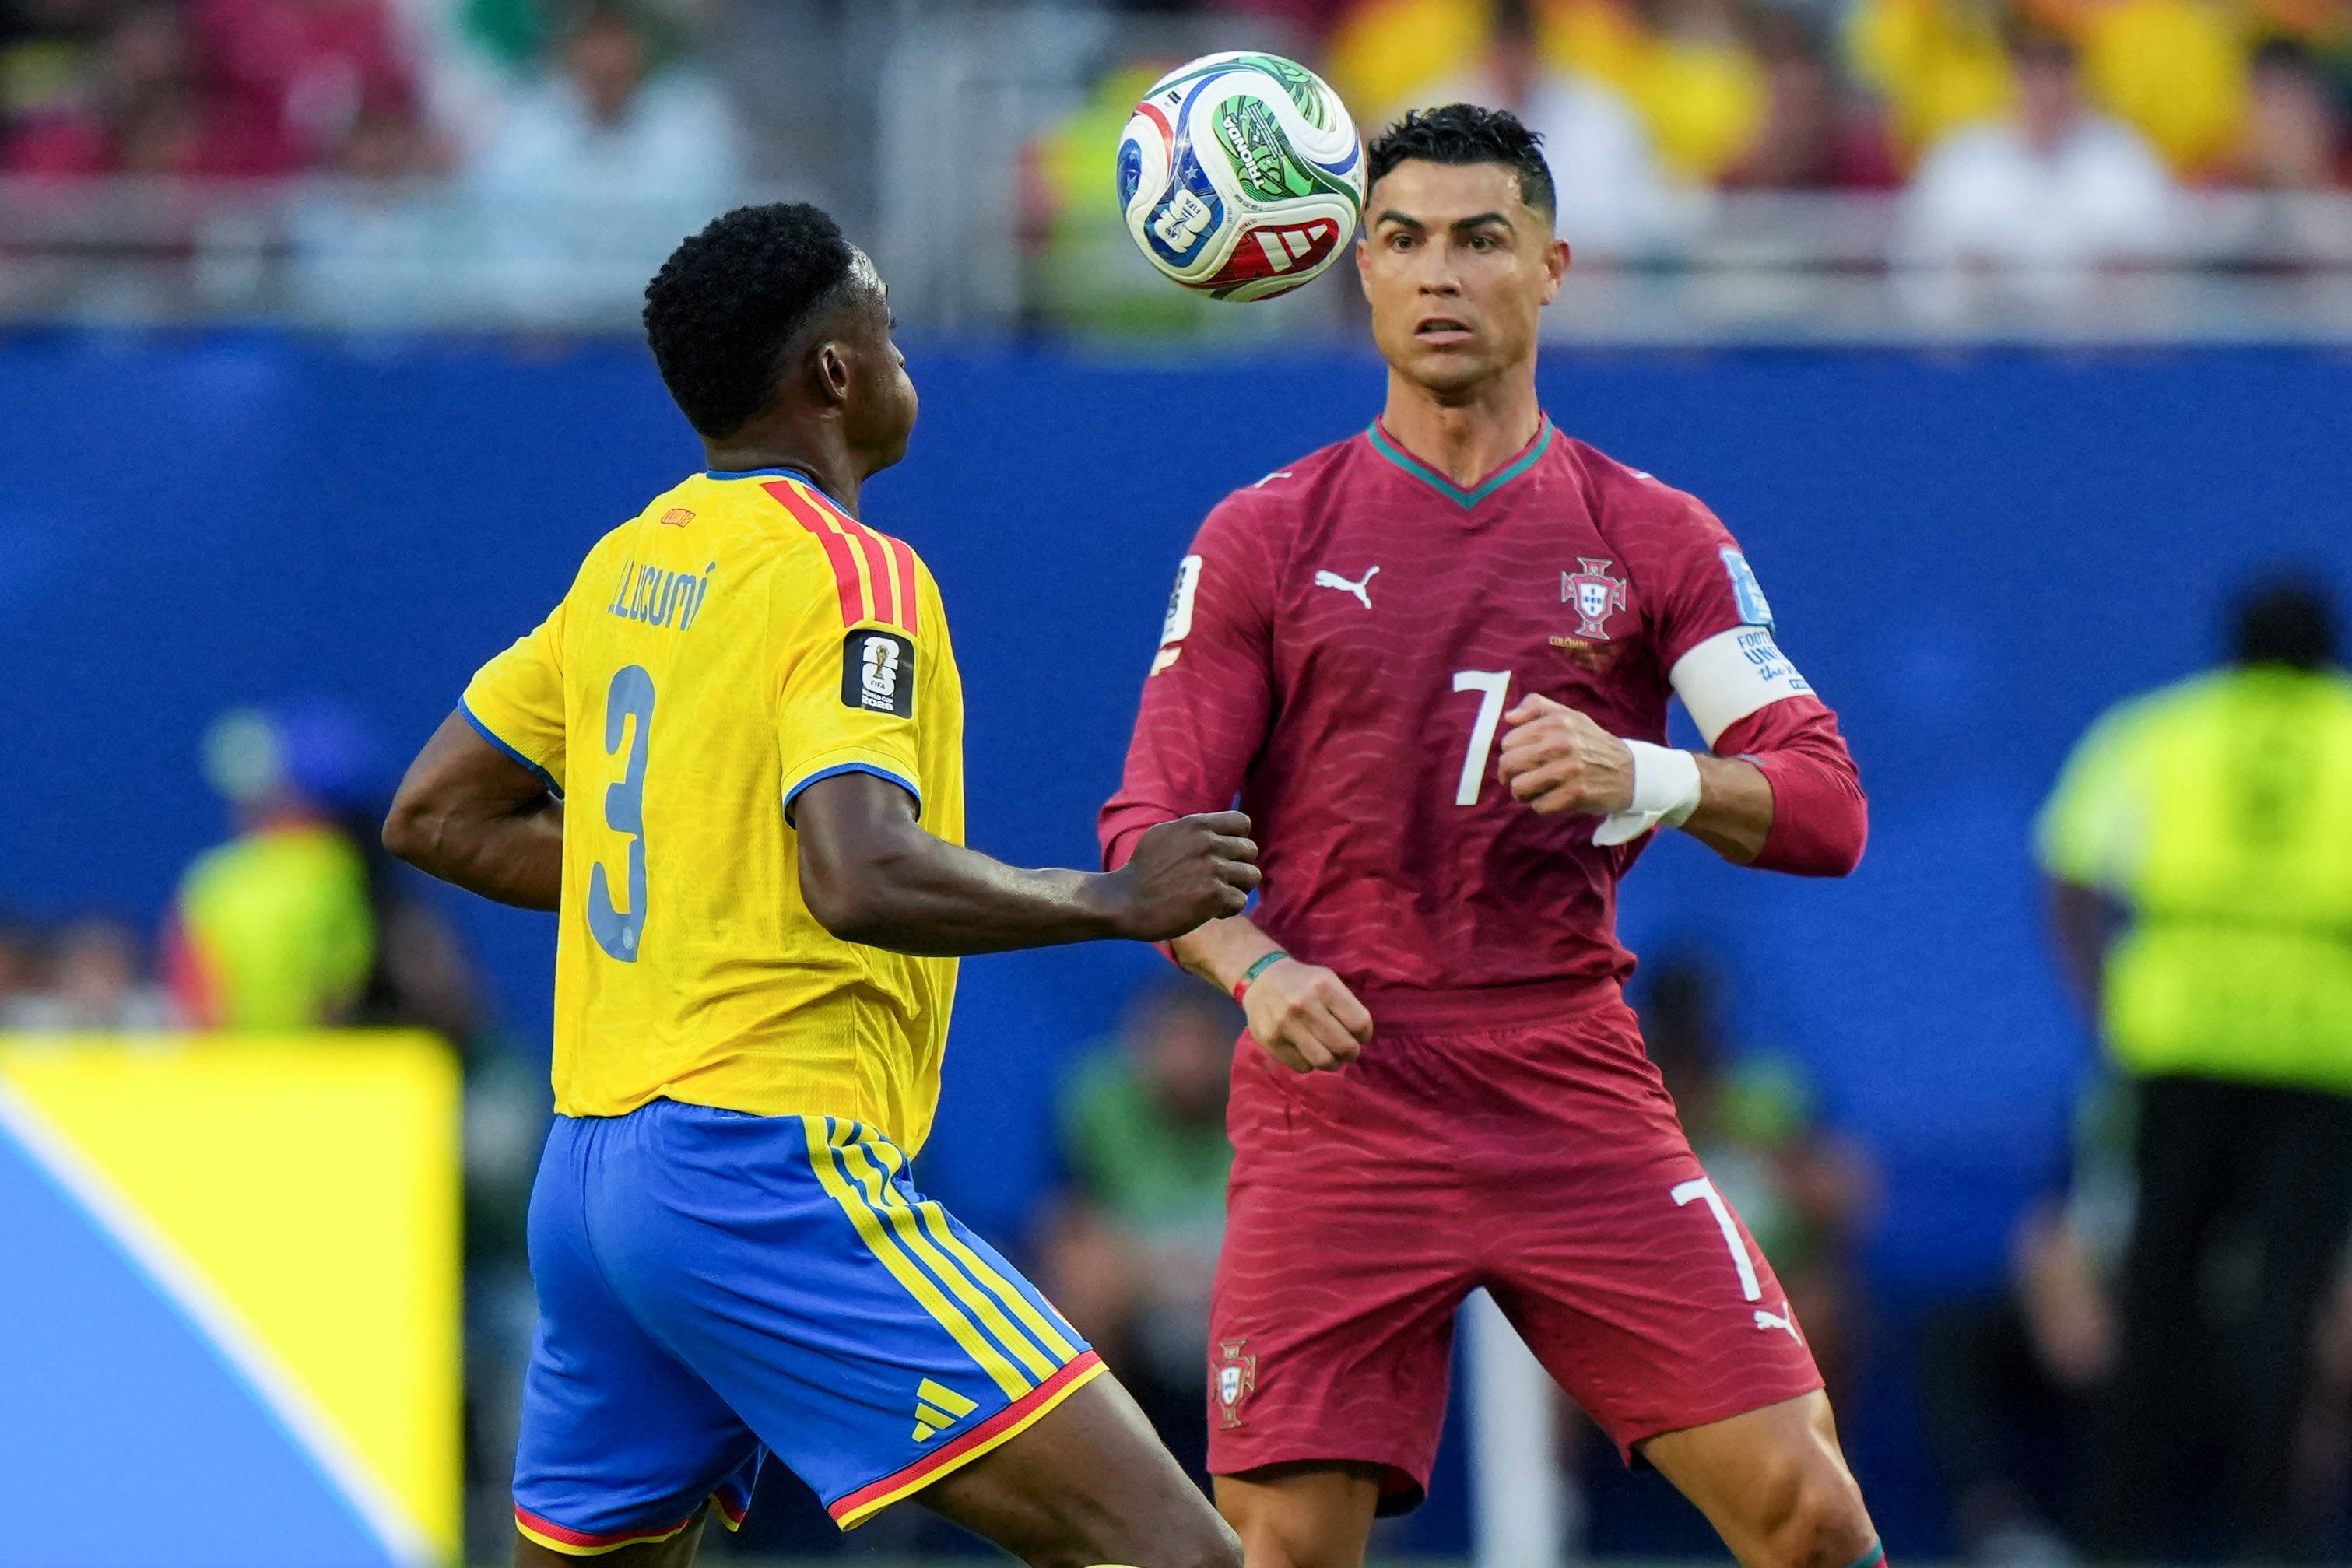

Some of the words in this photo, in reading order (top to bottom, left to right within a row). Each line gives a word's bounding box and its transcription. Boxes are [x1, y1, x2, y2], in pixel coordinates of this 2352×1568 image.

[1223, 115, 1265, 190] TRIONDA
[1185, 198, 1201, 215] FIFA
[862, 694, 894, 710] 2026
[871, 679, 886, 689] FIFA
[1452, 670, 1511, 805] 7
[588, 664, 655, 963] 3
[1670, 1177, 1762, 1302] 7
